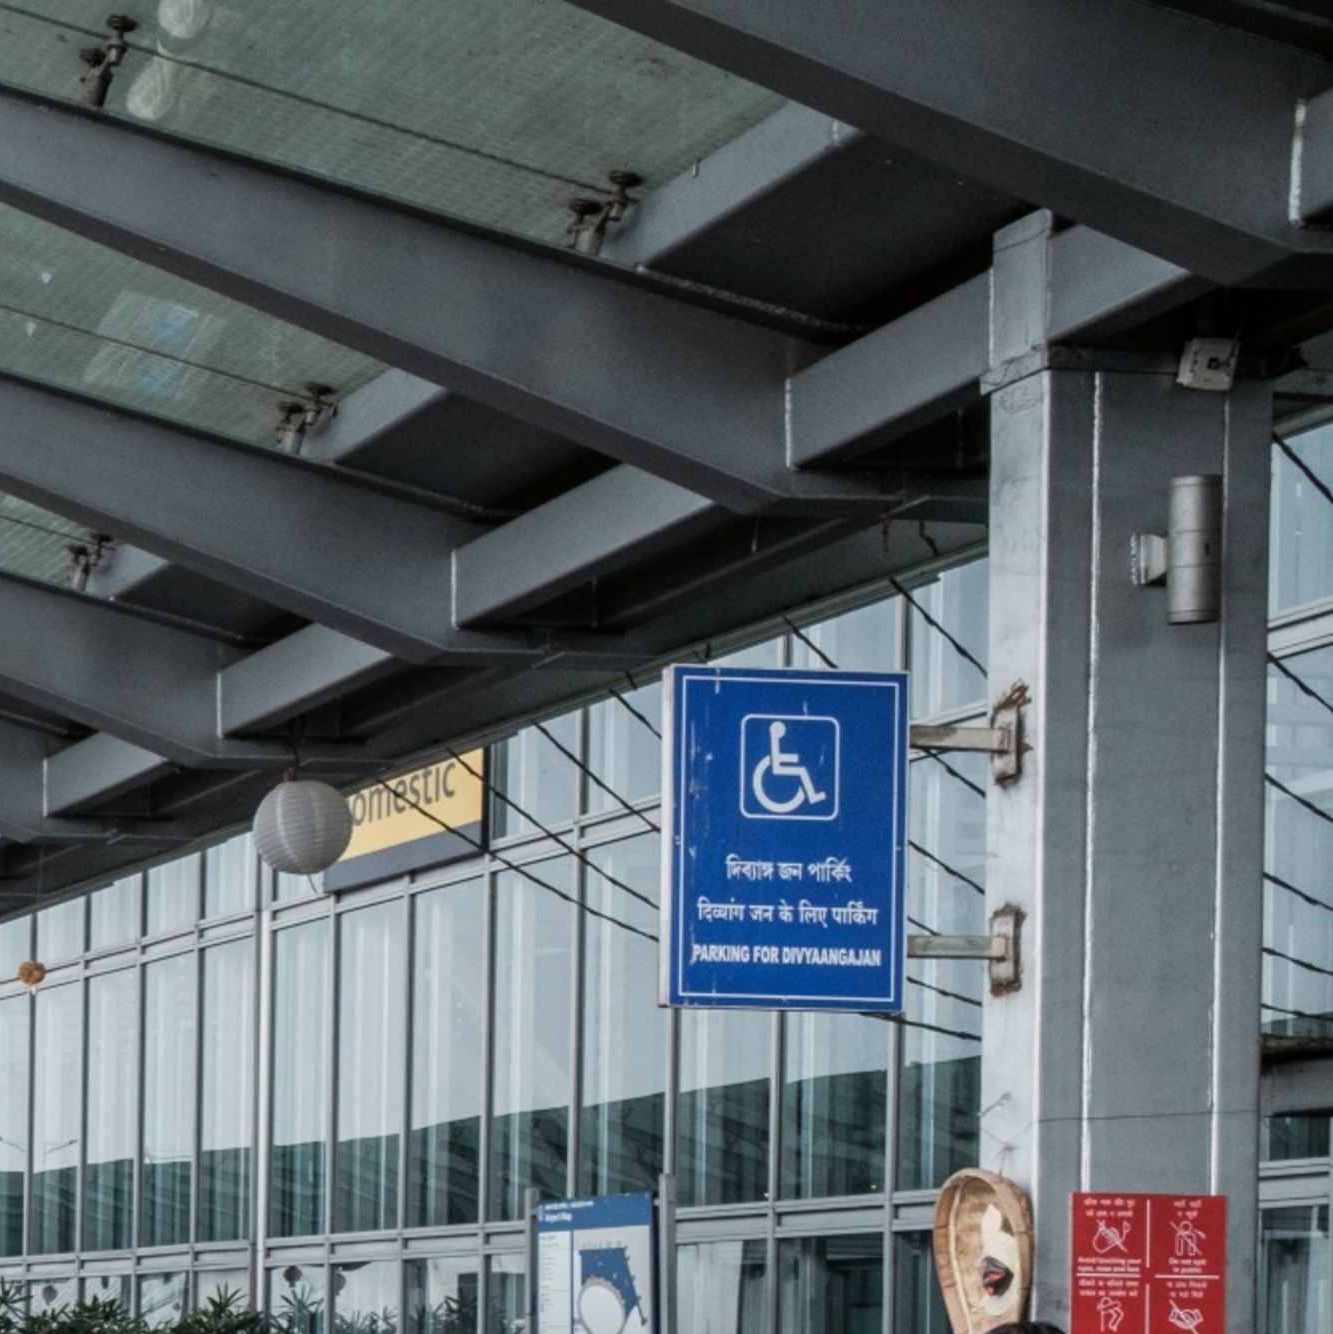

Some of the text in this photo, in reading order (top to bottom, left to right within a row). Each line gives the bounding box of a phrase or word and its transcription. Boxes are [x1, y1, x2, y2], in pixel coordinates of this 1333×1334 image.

[352, 761, 456, 826] omestic
[778, 860, 803, 882] জন
[697, 896, 879, 928] दिव्यांग जन के लिए पार्किंग
[694, 944, 882, 967] PARKING FOR DIVYAANGAJAN
